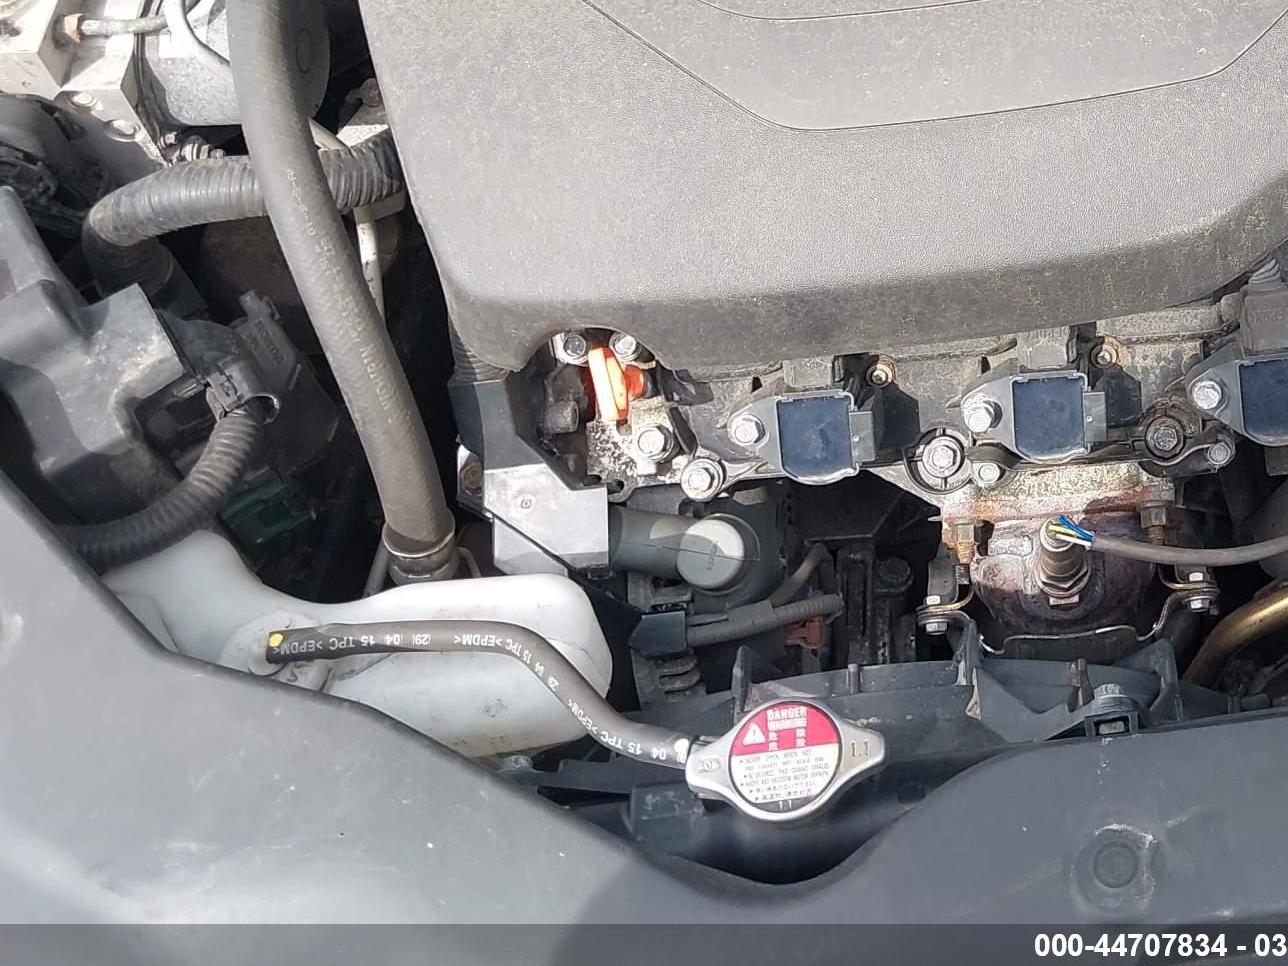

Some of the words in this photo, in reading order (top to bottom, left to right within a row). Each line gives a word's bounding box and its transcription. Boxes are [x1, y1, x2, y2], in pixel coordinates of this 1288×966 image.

[329, 636, 355, 651] TPC
[360, 635, 375, 646] 15
[454, 633, 502, 647] >EPDM<
[505, 638, 523, 657] TPC
[522, 649, 533, 664] 15
[568, 698, 598, 734] >EPDM<
[767, 707, 807, 719] DANGER
[600, 730, 624, 750] TPC
[628, 742, 642, 756] 15
[651, 746, 667, 760] 04
[851, 739, 870, 758] 1.1
